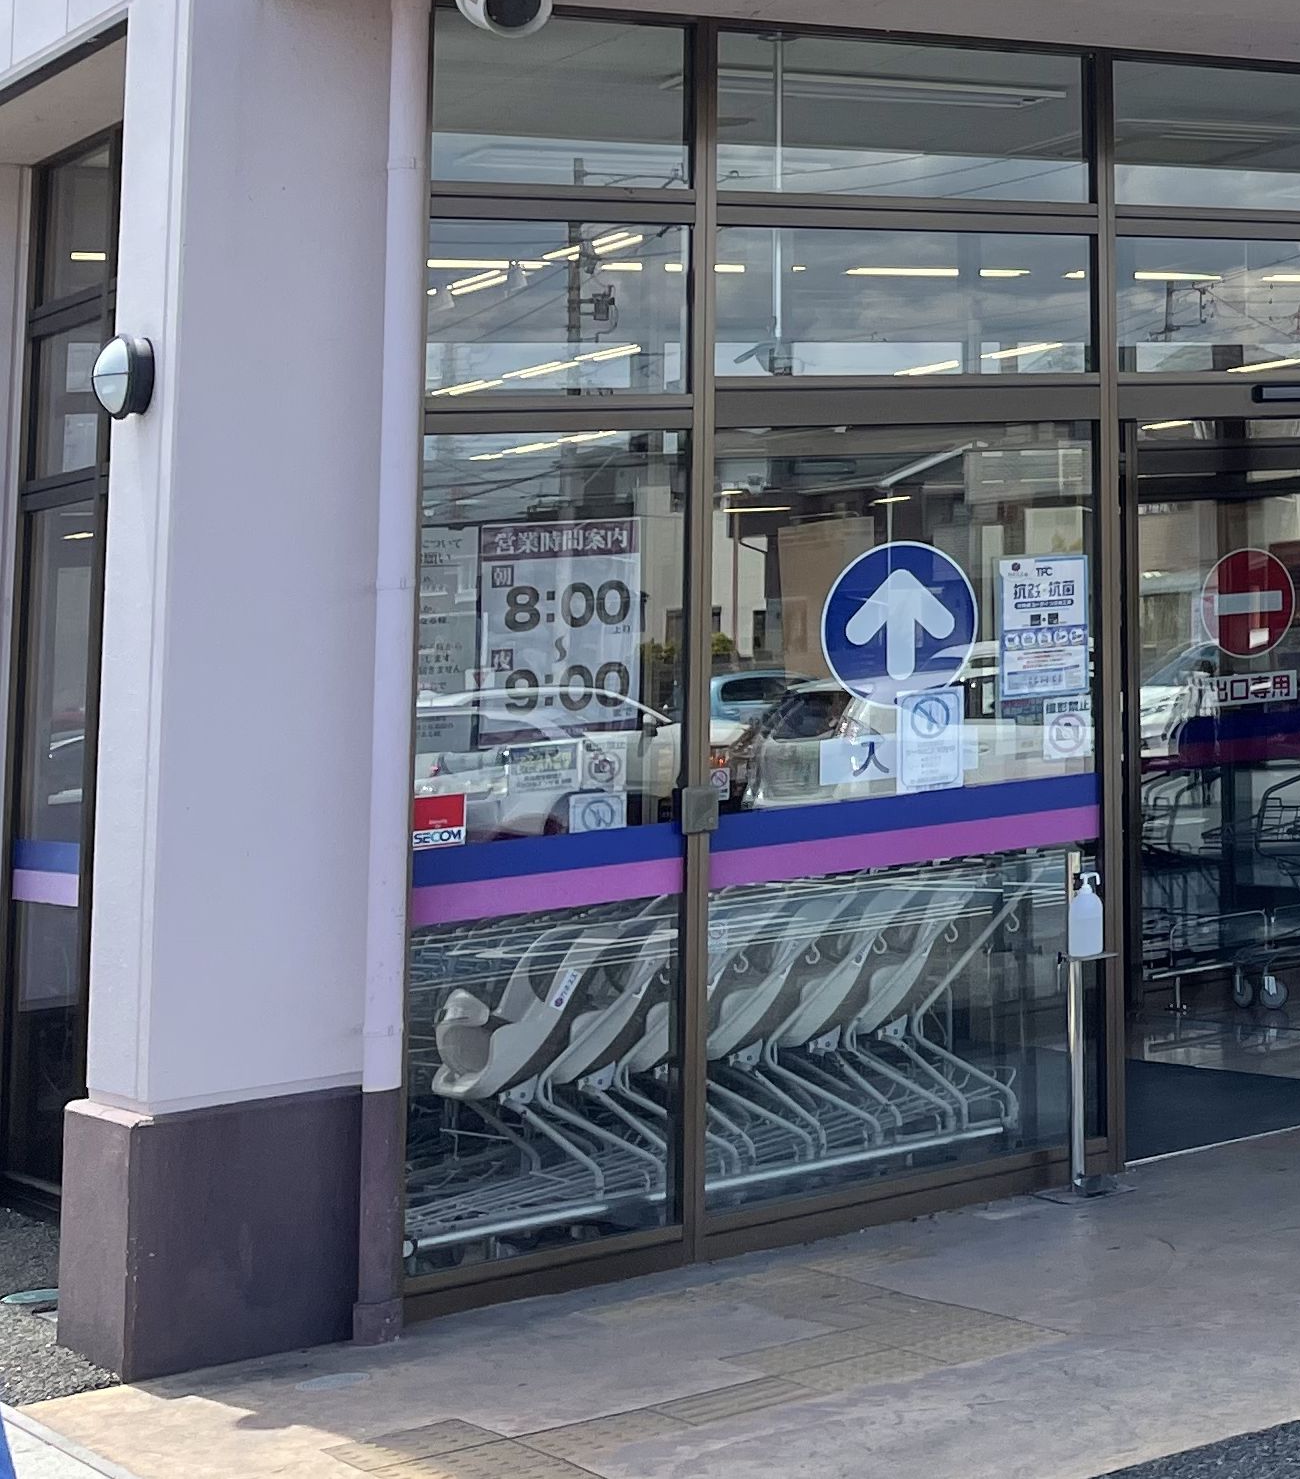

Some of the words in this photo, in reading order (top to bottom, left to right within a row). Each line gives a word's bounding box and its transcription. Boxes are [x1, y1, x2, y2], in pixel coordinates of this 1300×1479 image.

[495, 528, 628, 555] 営業時間案内
[493, 566, 512, 586] 朝
[504, 580, 631, 633] 8:00
[505, 661, 630, 715] 9:00
[414, 829, 462, 845] SECOM
